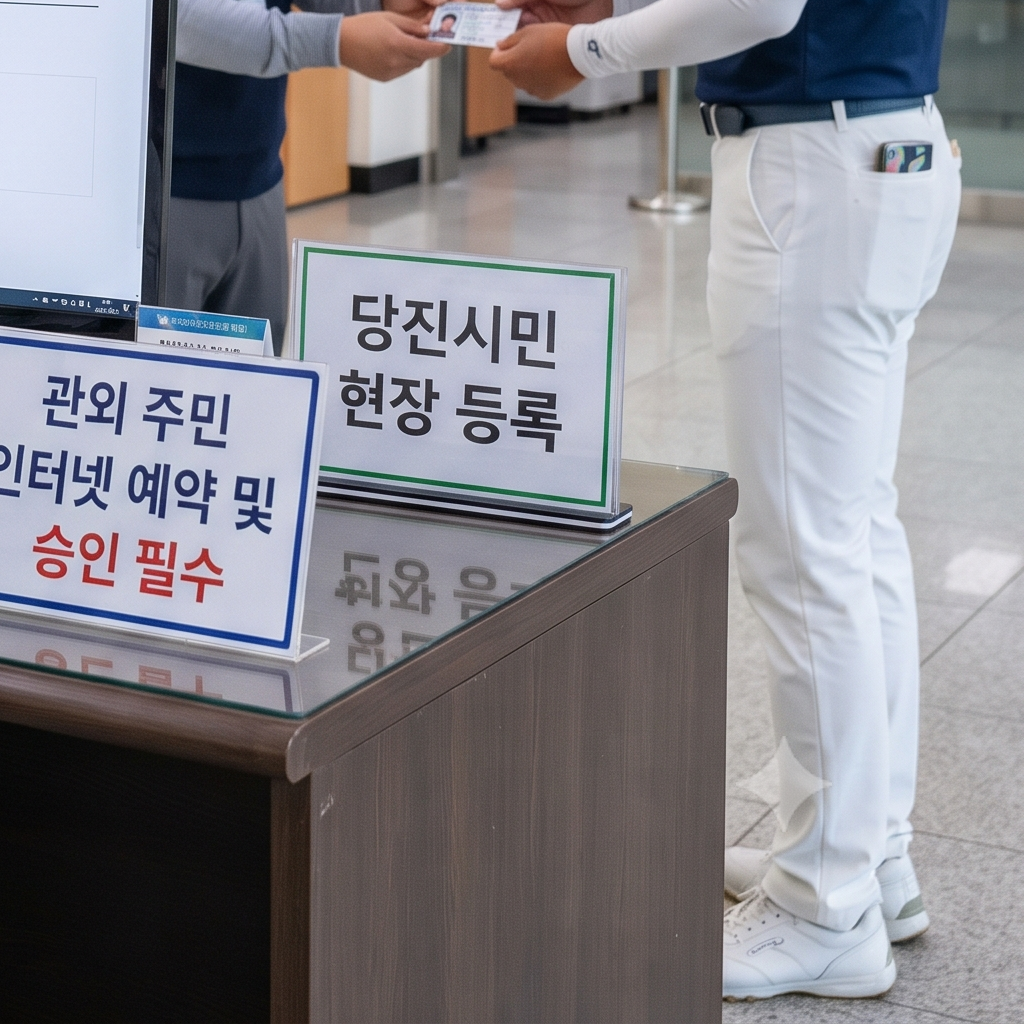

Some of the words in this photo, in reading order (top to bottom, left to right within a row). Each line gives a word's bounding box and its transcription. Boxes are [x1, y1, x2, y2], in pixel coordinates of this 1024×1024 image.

[351, 293, 557, 371] 당진시민
[42, 375, 128, 436] 관외
[142, 387, 231, 449] 주민
[339, 369, 440, 437] 현장
[455, 383, 563, 453] 등록
[127, 463, 218, 525] 예약
[233, 475, 276, 535] 및
[32, 525, 119, 587] 승인
[136, 538, 224, 603] 필수
